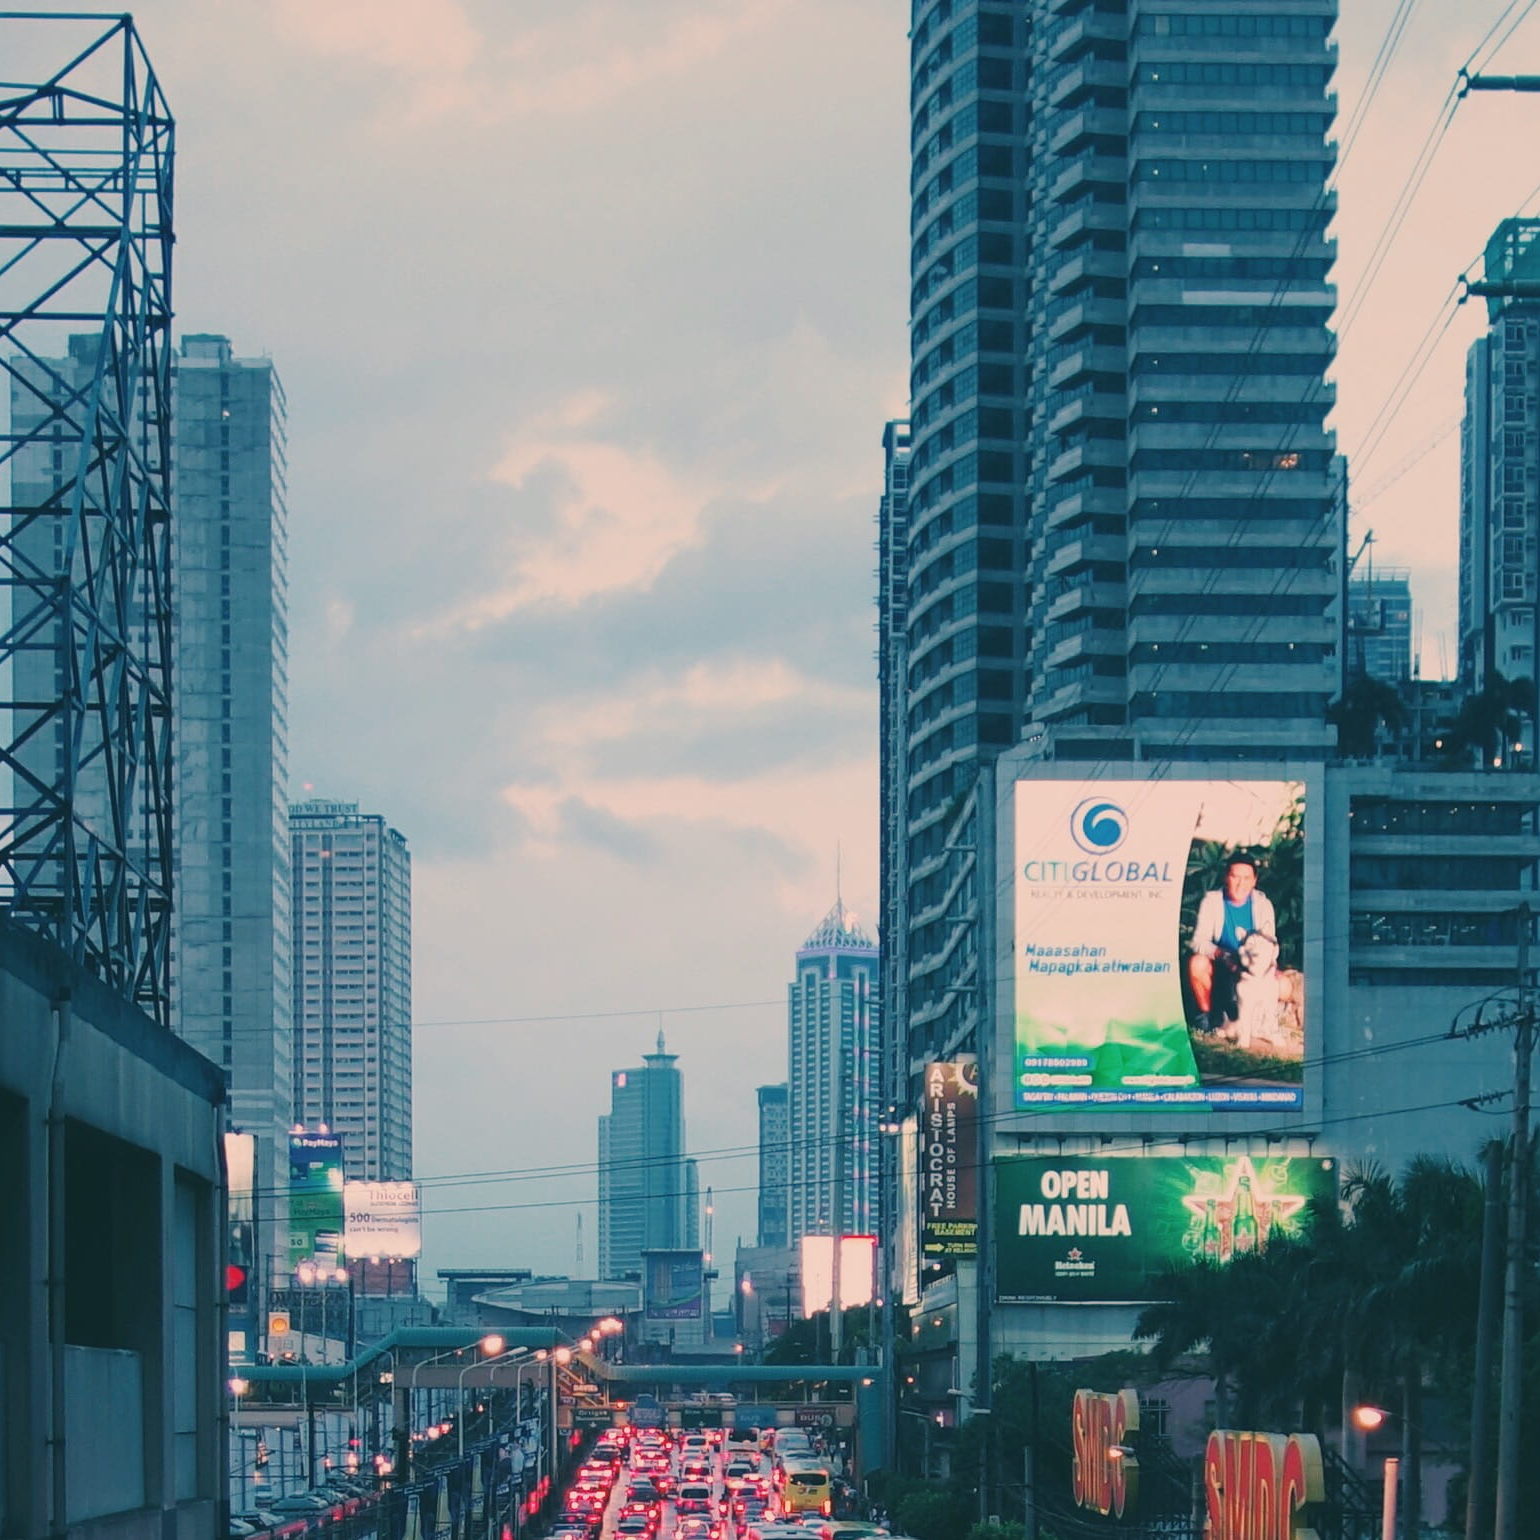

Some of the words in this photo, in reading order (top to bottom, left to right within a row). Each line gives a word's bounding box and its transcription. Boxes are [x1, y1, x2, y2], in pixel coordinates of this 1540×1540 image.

[1023, 860, 1174, 883] CITIGLOBAL
[1024, 943, 1107, 958] Maaasahan
[1028, 959, 1171, 976] Mapagkakatiwalaan
[946, 1102, 956, 1143] LAMPS
[928, 1067, 945, 1217] ARISTOCRAT
[946, 1148, 956, 1164] OF
[946, 1169, 956, 1209] HOUSE
[1040, 1169, 1110, 1200] OPEN
[348, 1211, 371, 1224] 500
[1018, 1203, 1133, 1237] MANILA
